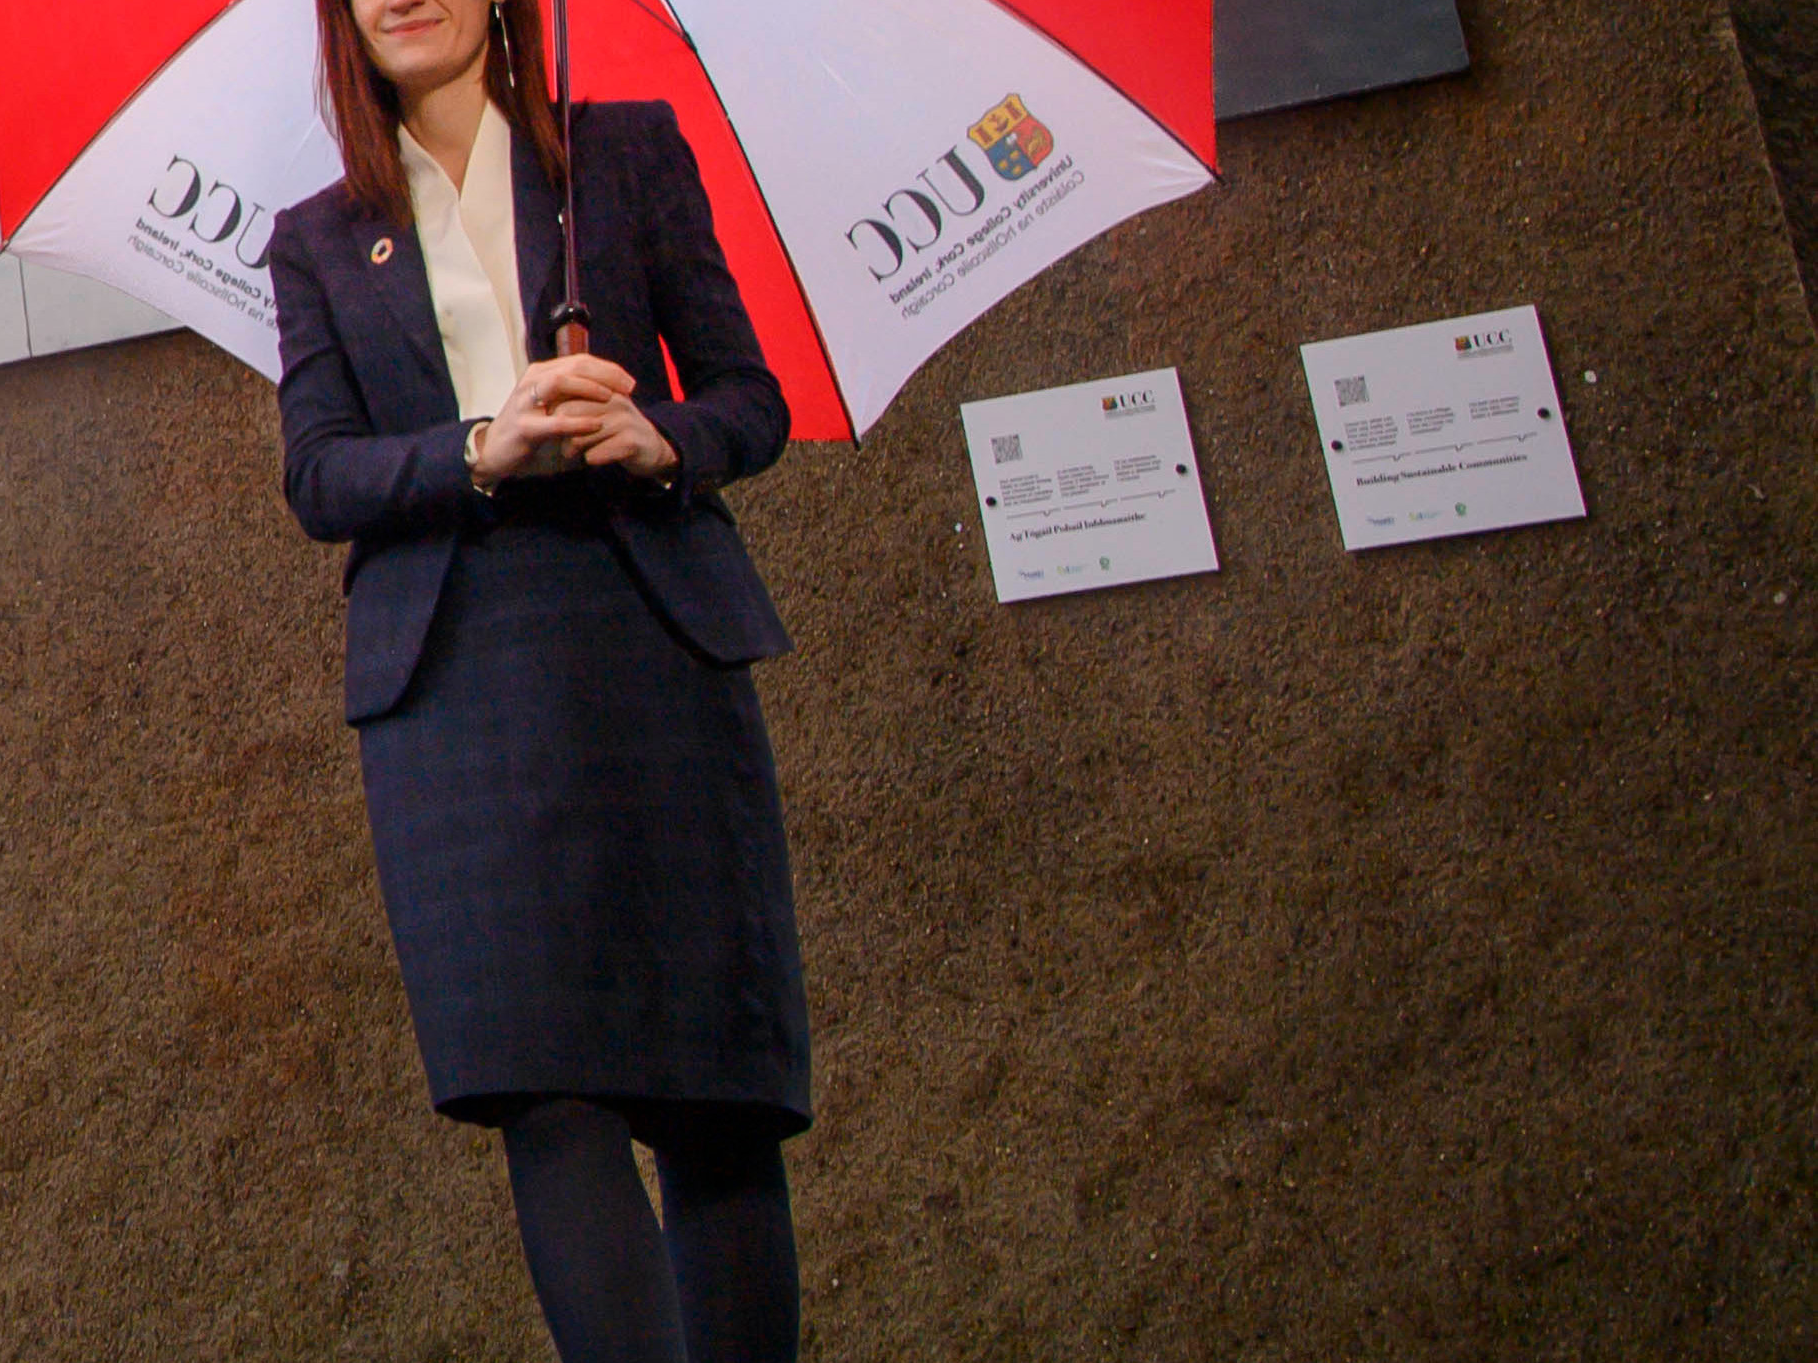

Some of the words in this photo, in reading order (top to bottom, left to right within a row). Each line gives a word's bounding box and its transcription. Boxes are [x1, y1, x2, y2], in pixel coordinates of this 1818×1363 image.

[1474, 329, 1512, 348] UCC
[1118, 390, 1155, 407] UCC
[1356, 471, 1399, 487] Building
[1401, 463, 1456, 478] Sustainable
[1459, 453, 1528, 471] Communities
